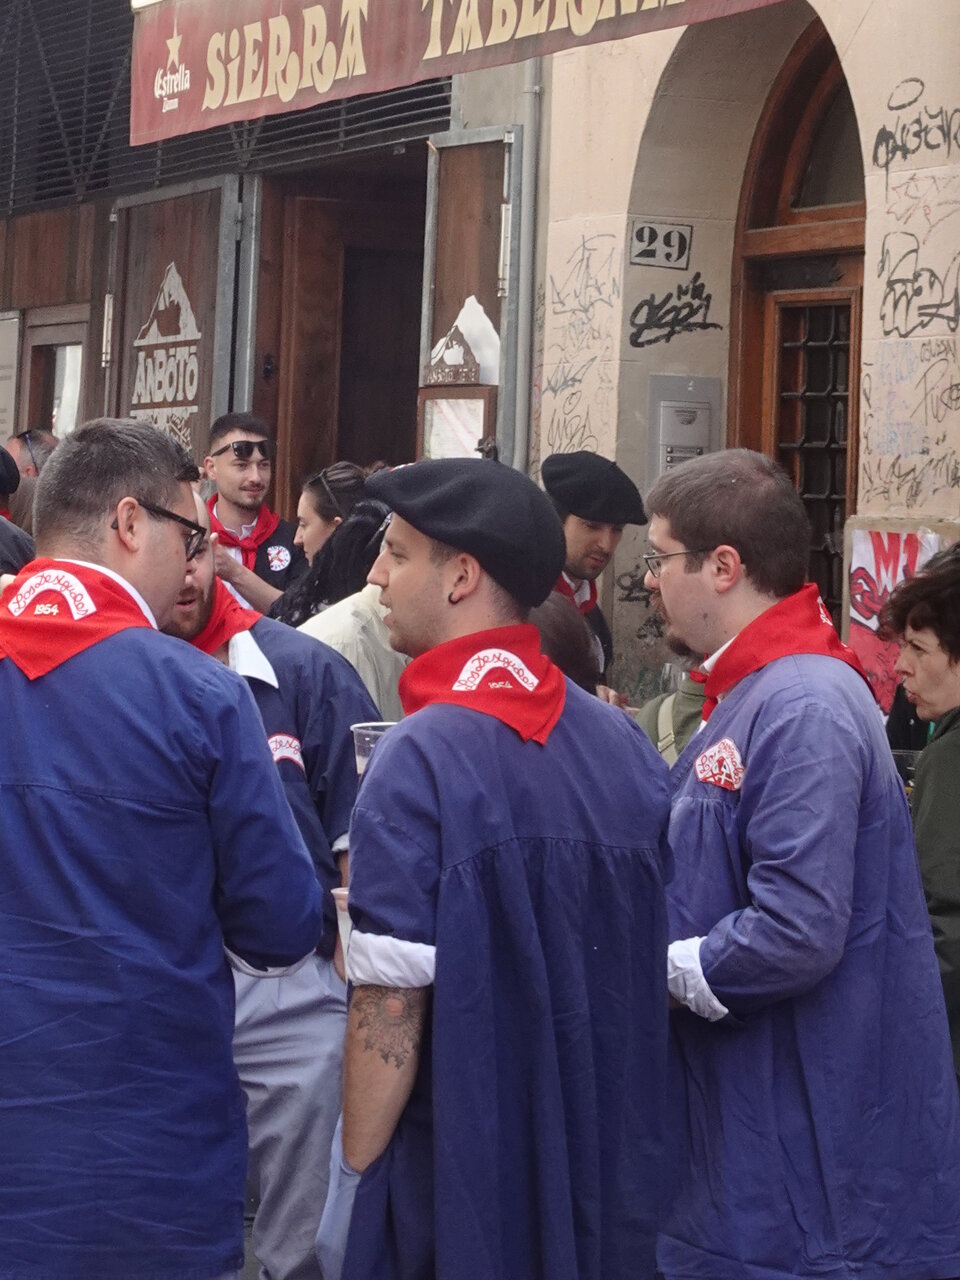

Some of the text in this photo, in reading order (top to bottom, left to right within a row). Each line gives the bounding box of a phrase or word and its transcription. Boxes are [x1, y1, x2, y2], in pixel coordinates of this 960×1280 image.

[154, 63, 190, 99] Estrella
[634, 226, 687, 263] 29
[34, 603, 59, 616] 1954
